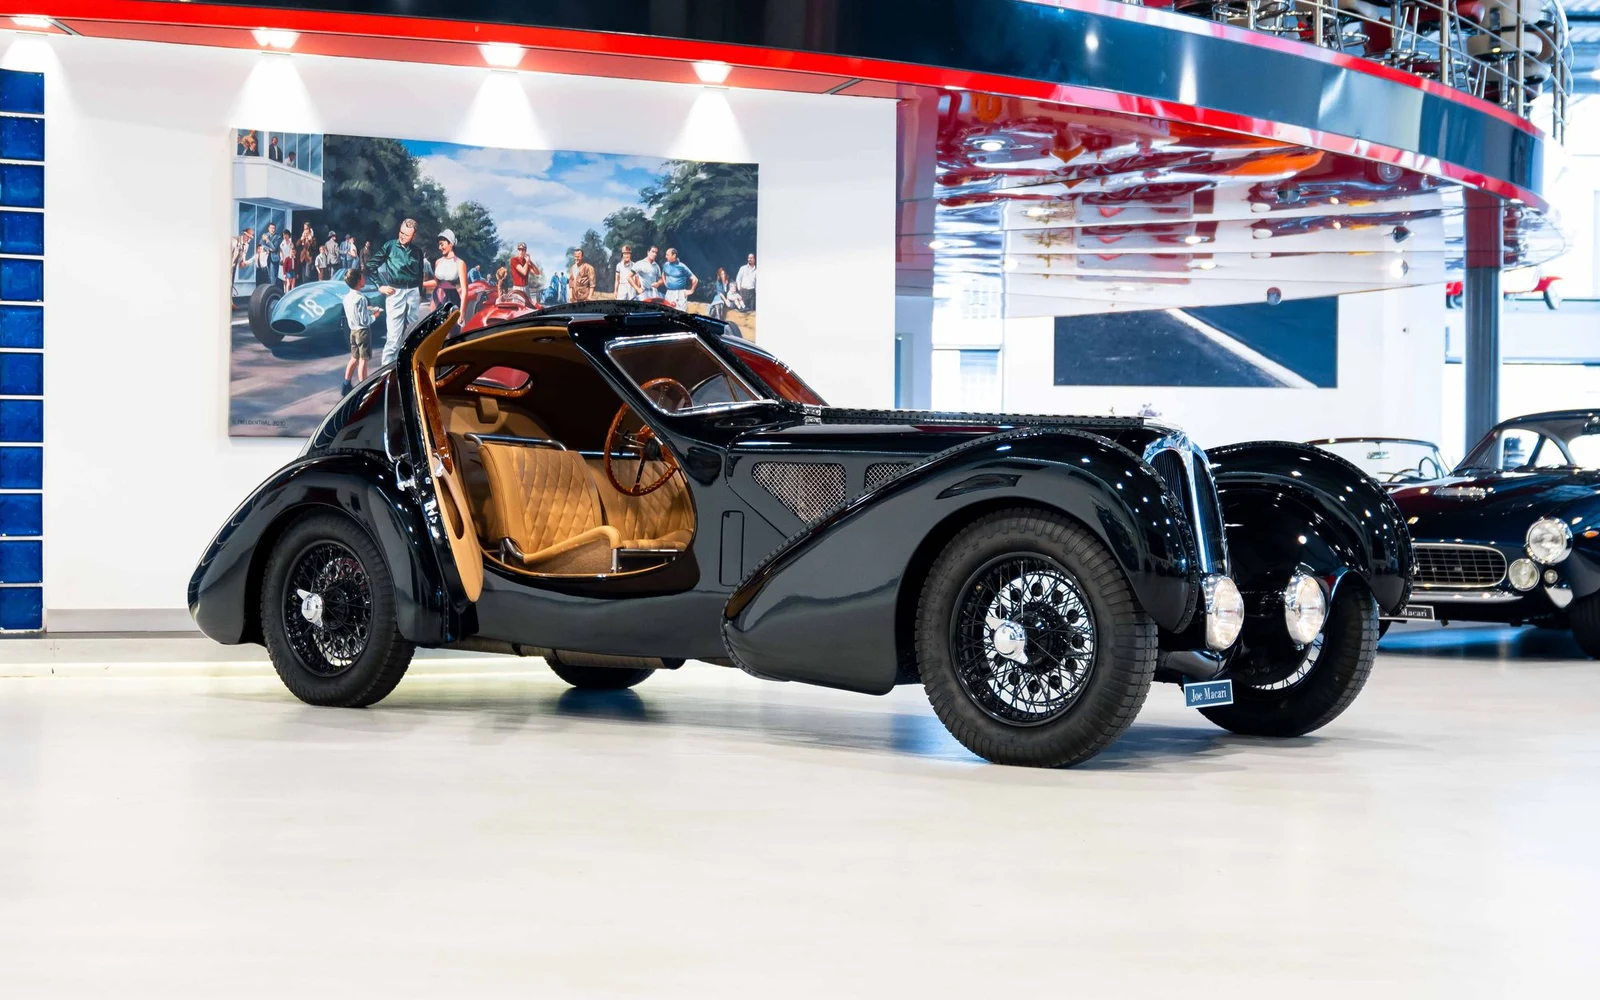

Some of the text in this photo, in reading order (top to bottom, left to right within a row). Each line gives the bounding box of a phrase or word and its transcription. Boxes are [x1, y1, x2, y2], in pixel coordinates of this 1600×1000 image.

[298, 299, 325, 318] 18
[1191, 686, 1227, 703] Joe Macari
